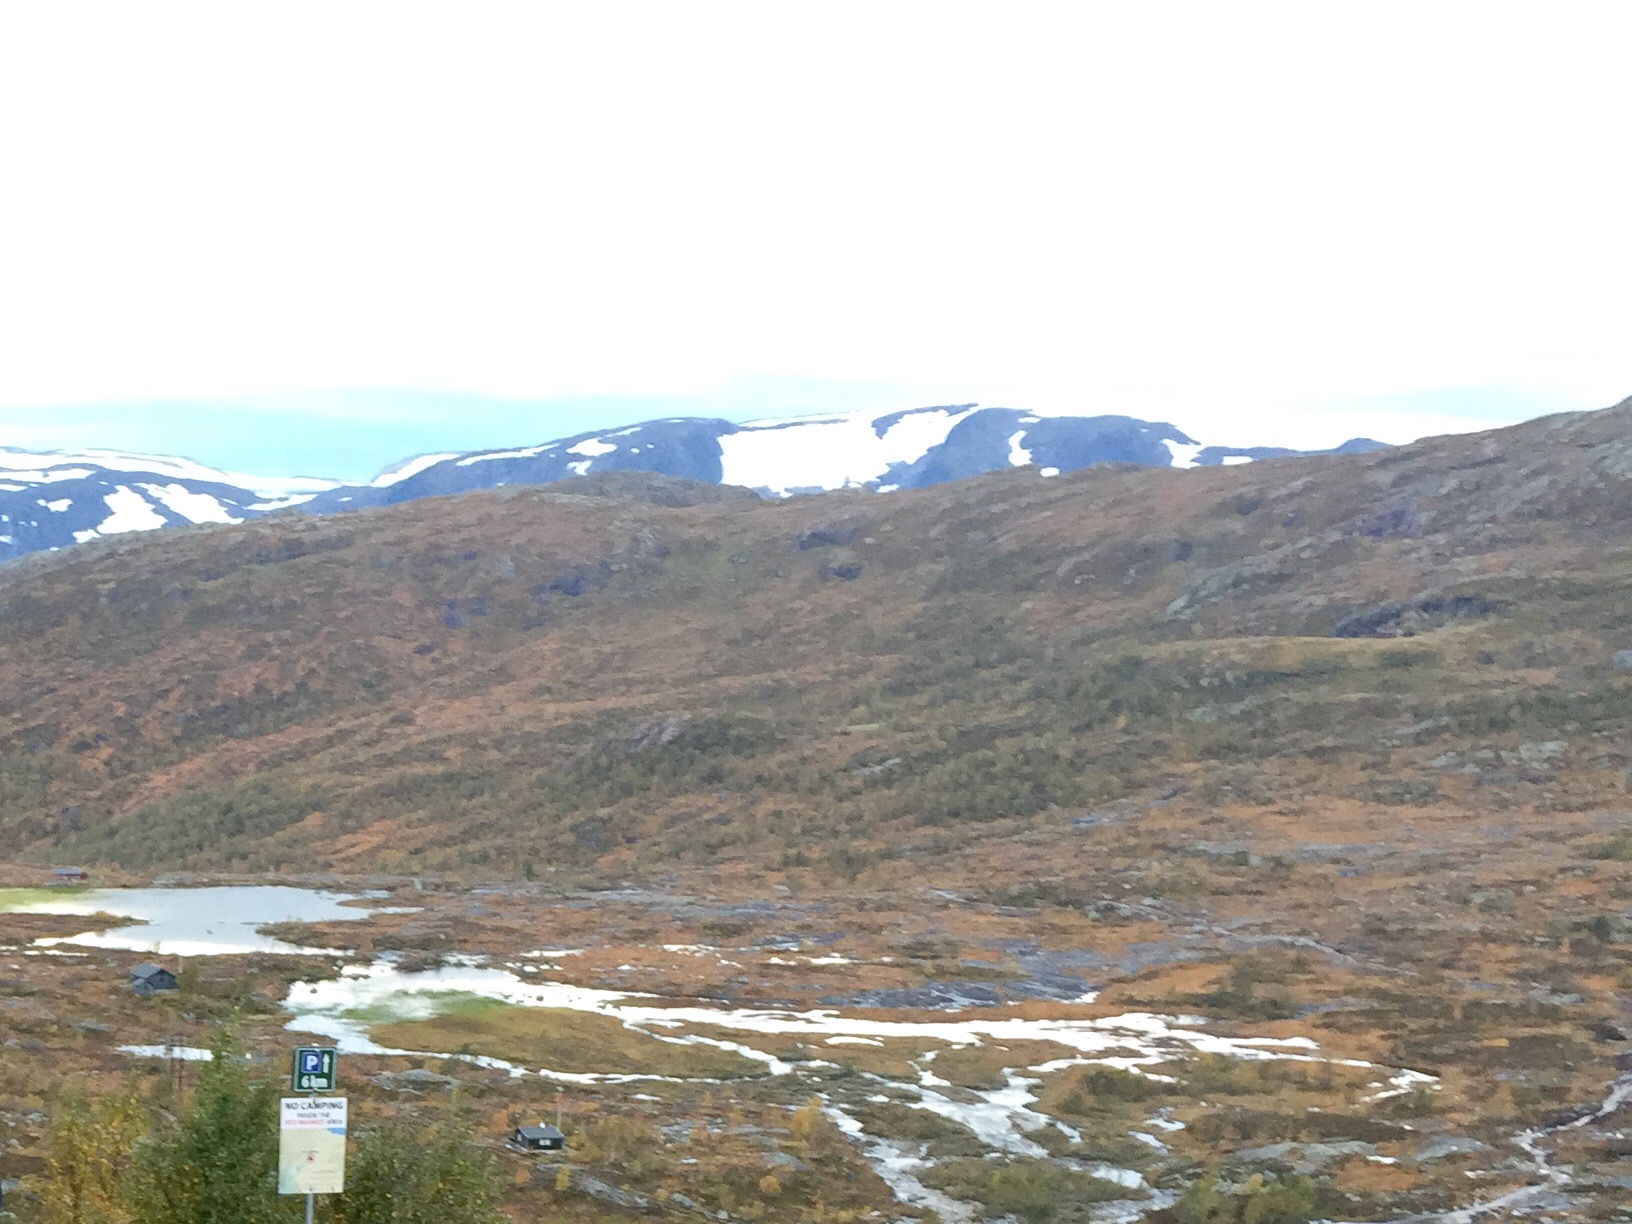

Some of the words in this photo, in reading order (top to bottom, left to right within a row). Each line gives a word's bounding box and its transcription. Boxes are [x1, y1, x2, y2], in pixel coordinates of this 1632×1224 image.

[306, 1055, 318, 1070] P
[285, 1102, 299, 1110] NO
[300, 1102, 343, 1110] CAMPING
